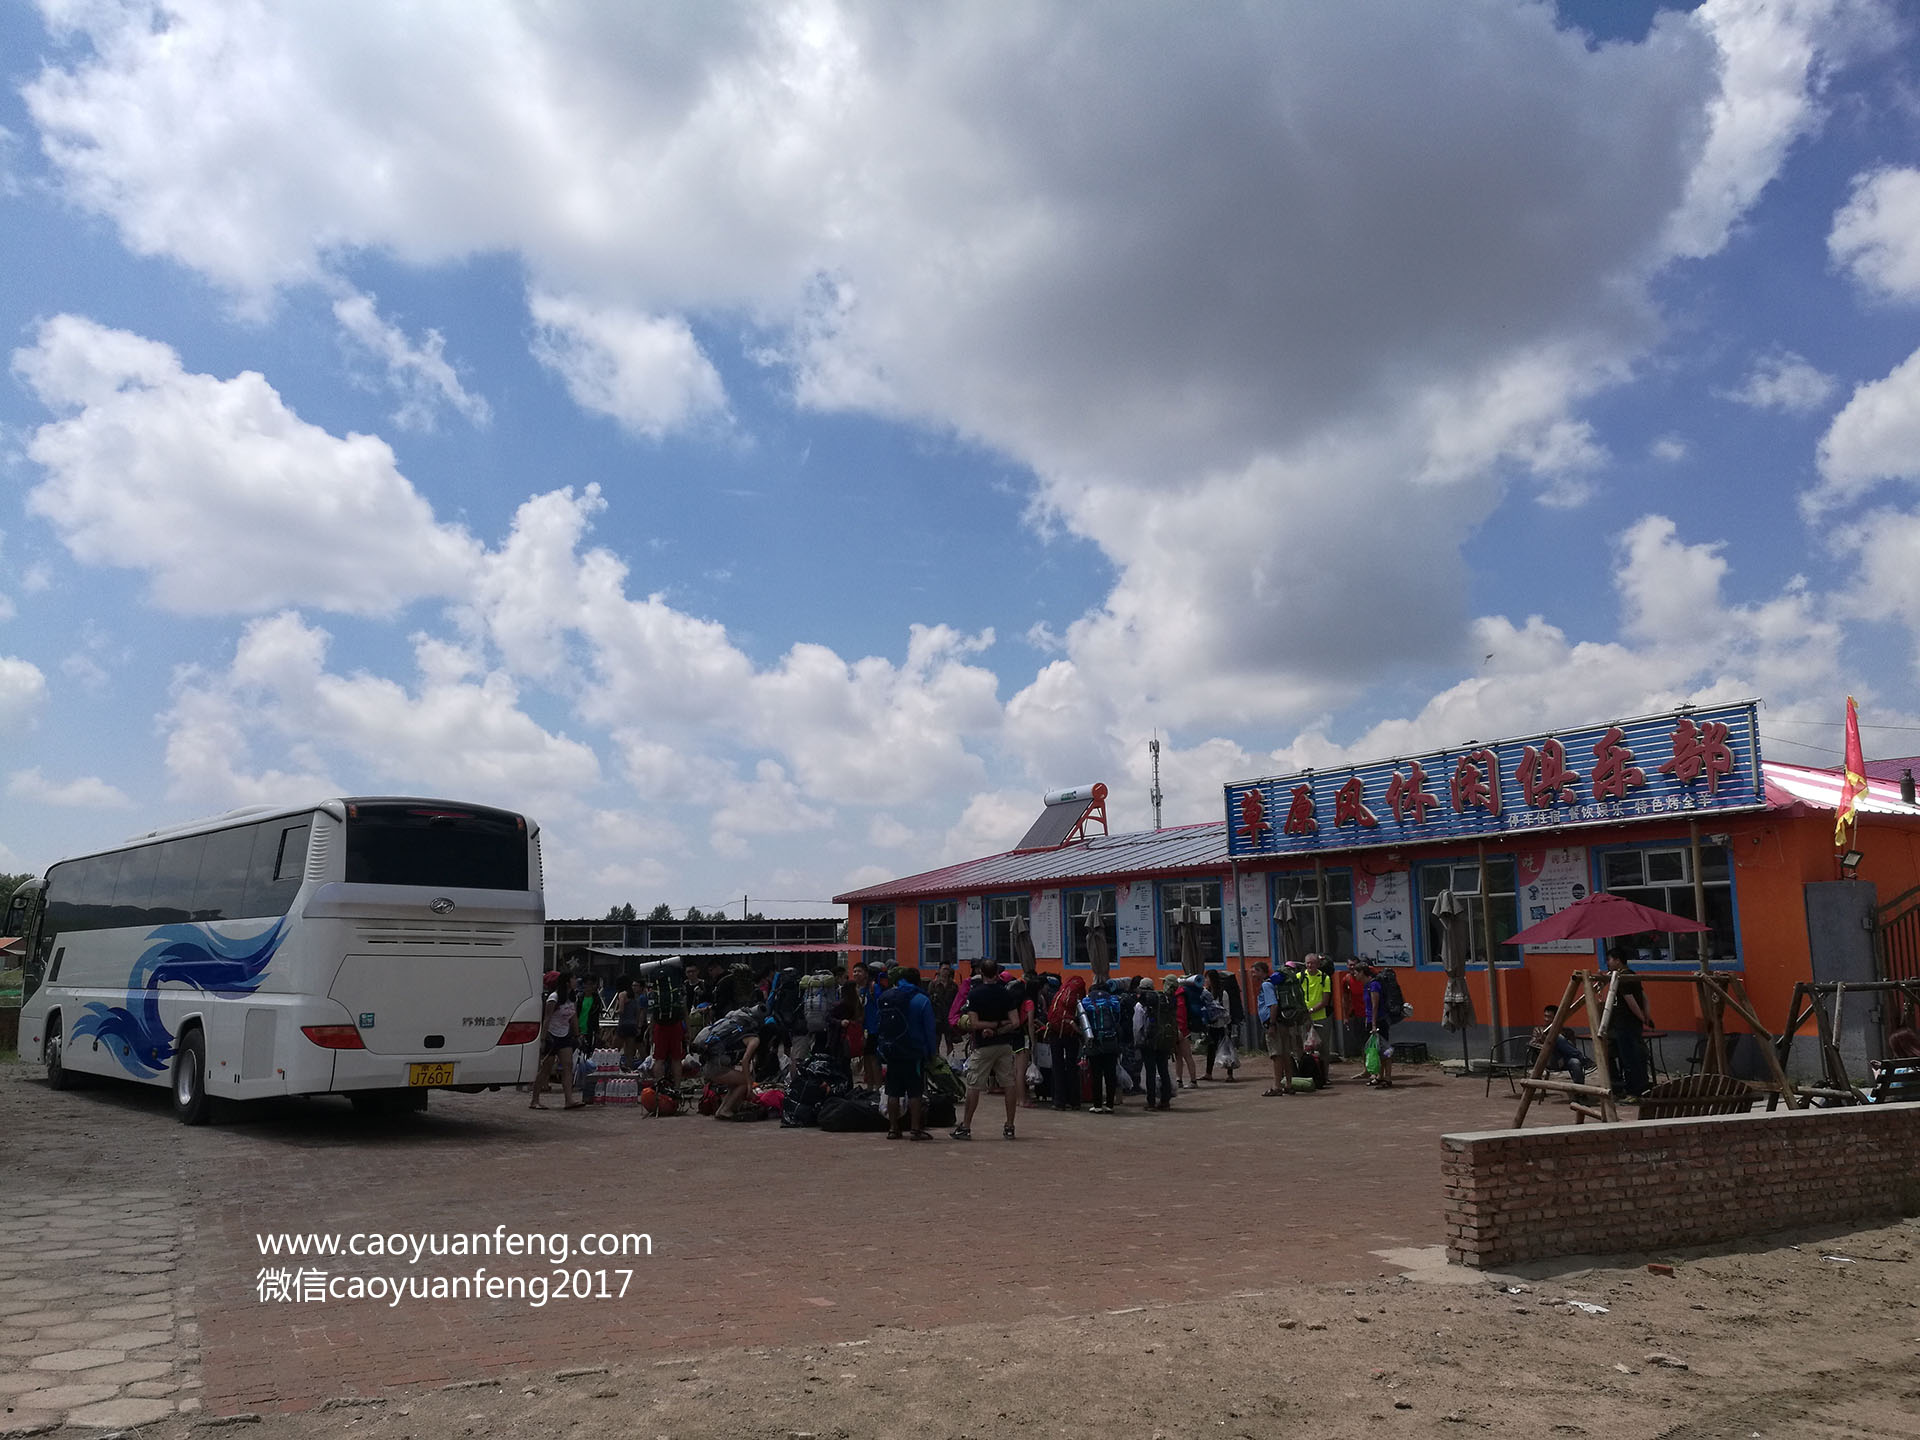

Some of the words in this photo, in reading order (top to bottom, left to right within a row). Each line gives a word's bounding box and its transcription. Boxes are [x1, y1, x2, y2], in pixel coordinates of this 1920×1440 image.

[1240, 718, 1735, 848] 草原风休闲俱乐部
[1508, 810, 1561, 827] 停车住宿
[1568, 802, 1624, 820] 餐饮娱乐
[1634, 793, 1712, 815] 特色烤全羊
[411, 1071, 452, 1086] J7607
